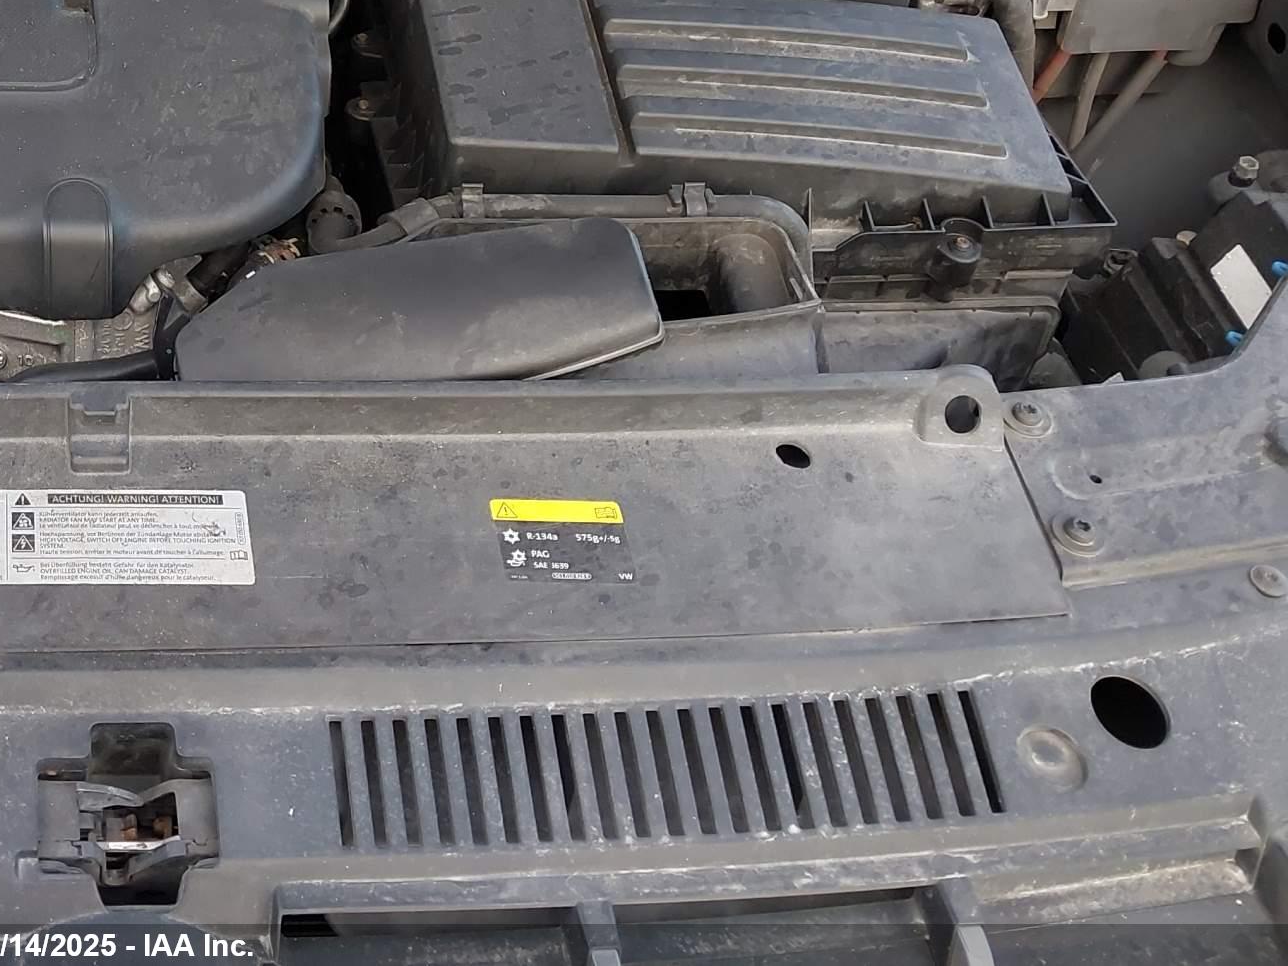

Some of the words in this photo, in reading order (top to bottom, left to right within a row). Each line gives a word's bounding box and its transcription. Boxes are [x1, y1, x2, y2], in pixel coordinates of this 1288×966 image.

[52, 494, 104, 503] ACHTUNG!
[107, 494, 159, 503] WARNING!
[161, 495, 219, 504] ATTENTION!
[526, 532, 558, 541] R-134a
[531, 550, 550, 558] PAG
